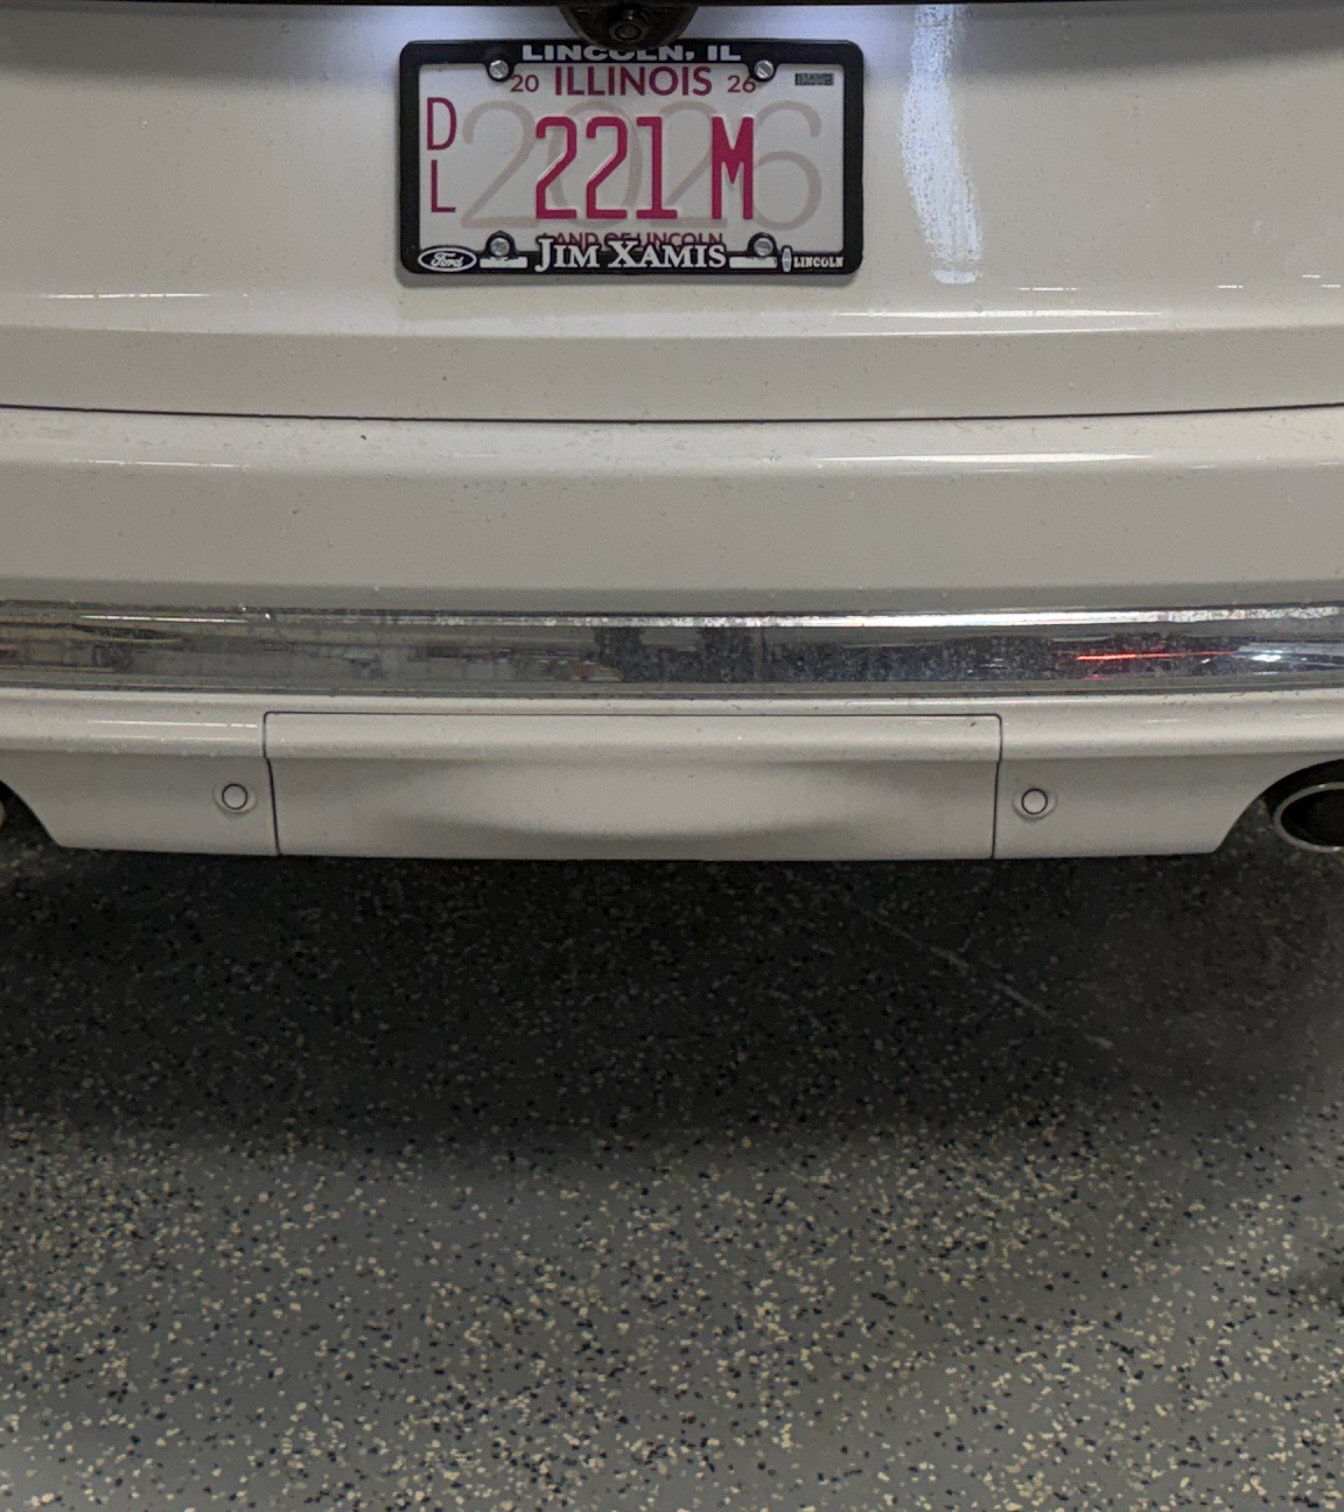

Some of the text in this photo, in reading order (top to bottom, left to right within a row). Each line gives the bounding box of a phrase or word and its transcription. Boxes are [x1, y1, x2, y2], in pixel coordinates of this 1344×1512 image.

[707, 45, 741, 61] IL
[510, 65, 757, 96] 20 ILLINOIS 26
[535, 115, 754, 220] 221 M
[431, 252, 463, 268] Ford
[535, 238, 726, 272] JIM XAMIS
[793, 256, 844, 268] LINCOLN
